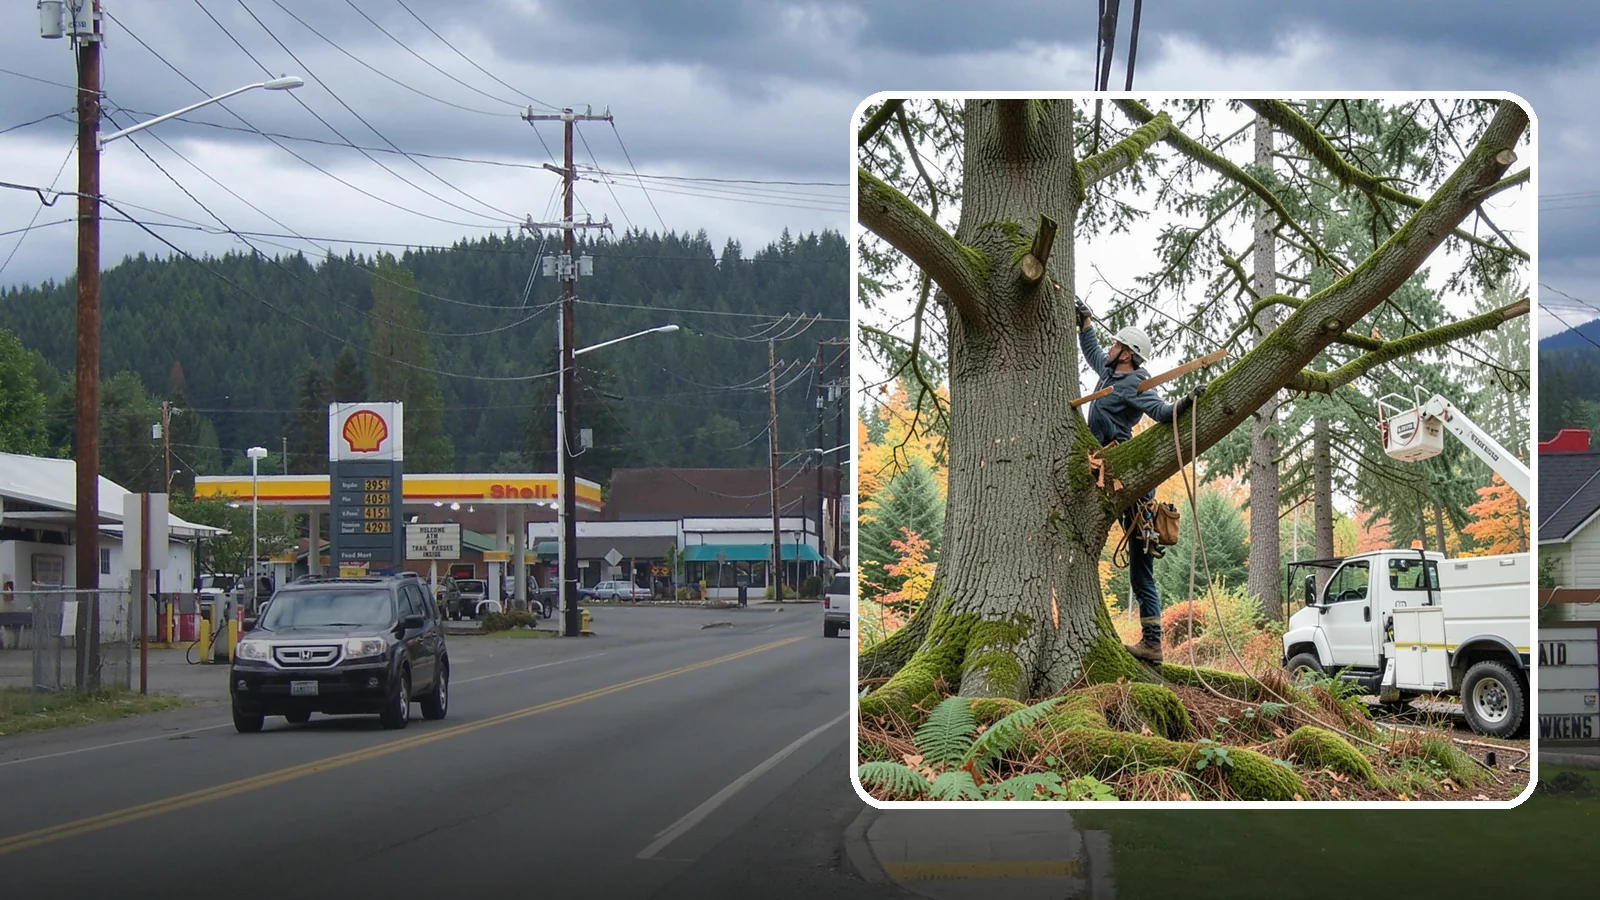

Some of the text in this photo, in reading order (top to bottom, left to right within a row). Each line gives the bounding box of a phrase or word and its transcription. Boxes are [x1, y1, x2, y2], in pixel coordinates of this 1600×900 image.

[366, 480, 384, 490] 395
[490, 484, 548, 499] Shell
[366, 494, 384, 504] 405
[366, 508, 383, 518] 415
[365, 522, 384, 532] 429
